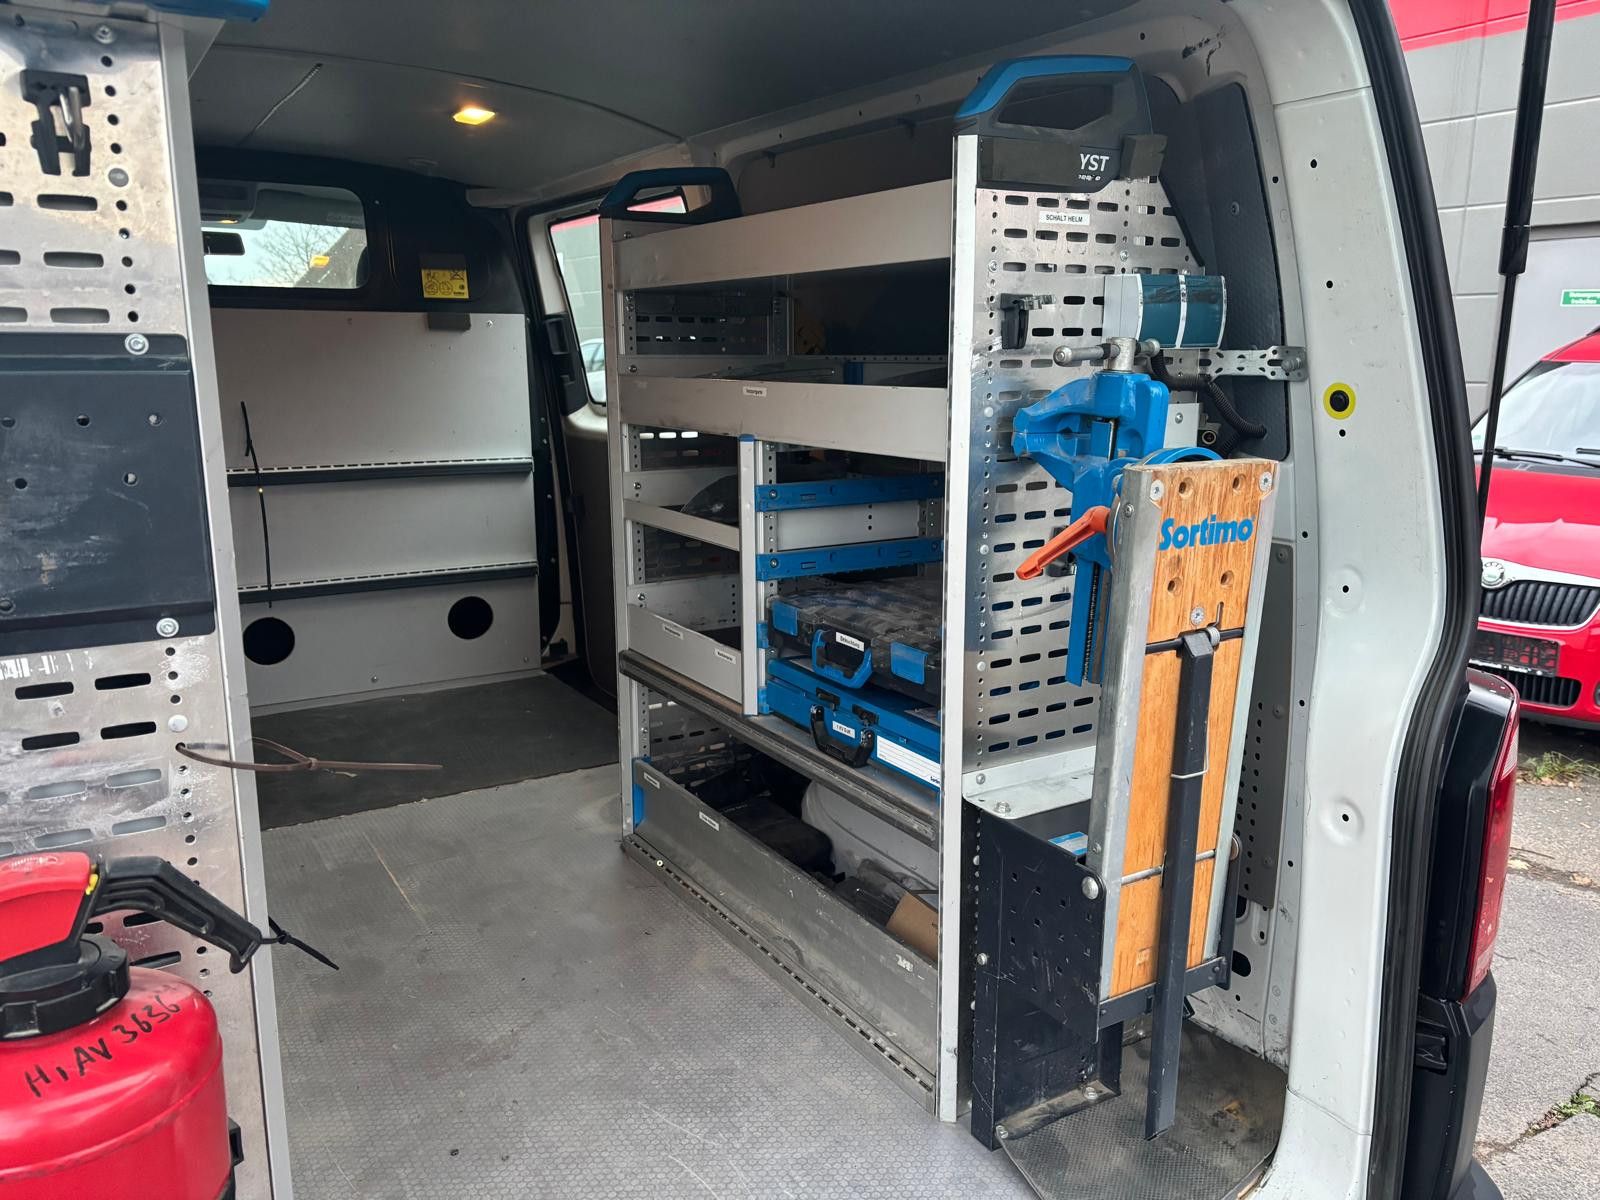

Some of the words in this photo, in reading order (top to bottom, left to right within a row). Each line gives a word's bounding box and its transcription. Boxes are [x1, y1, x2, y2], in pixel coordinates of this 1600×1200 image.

[1079, 153, 1110, 171] YST
[1046, 214, 1067, 222] SCHALT
[1158, 514, 1253, 551] Sortimo
